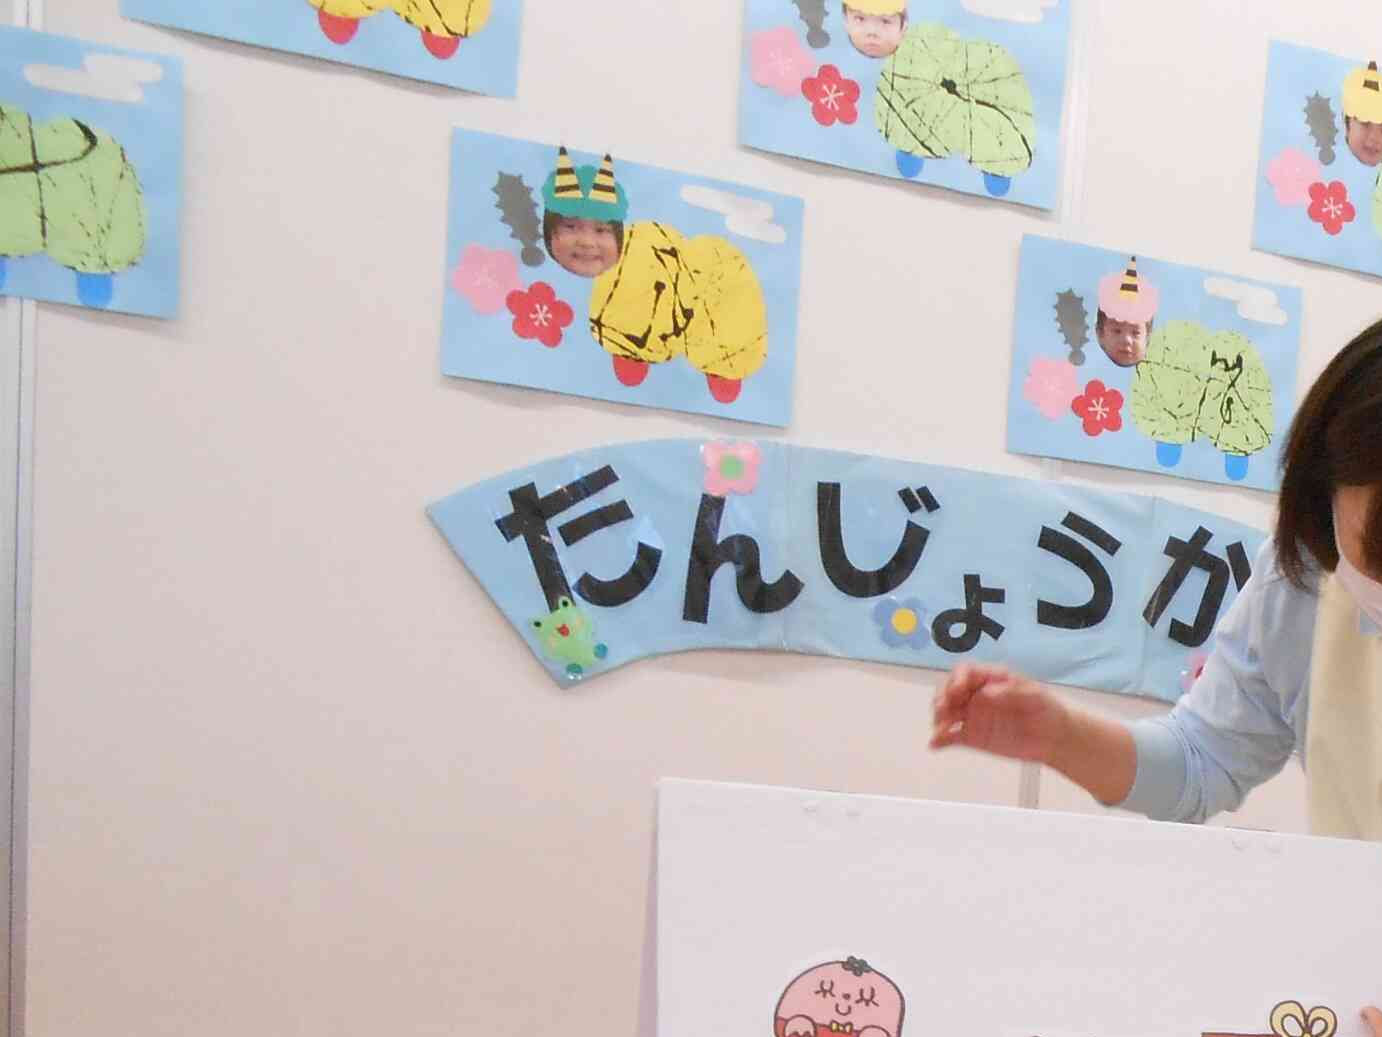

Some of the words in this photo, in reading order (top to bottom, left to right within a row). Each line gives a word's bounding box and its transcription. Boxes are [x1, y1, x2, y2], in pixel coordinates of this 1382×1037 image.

[495, 464, 1252, 653] たんじょうか
